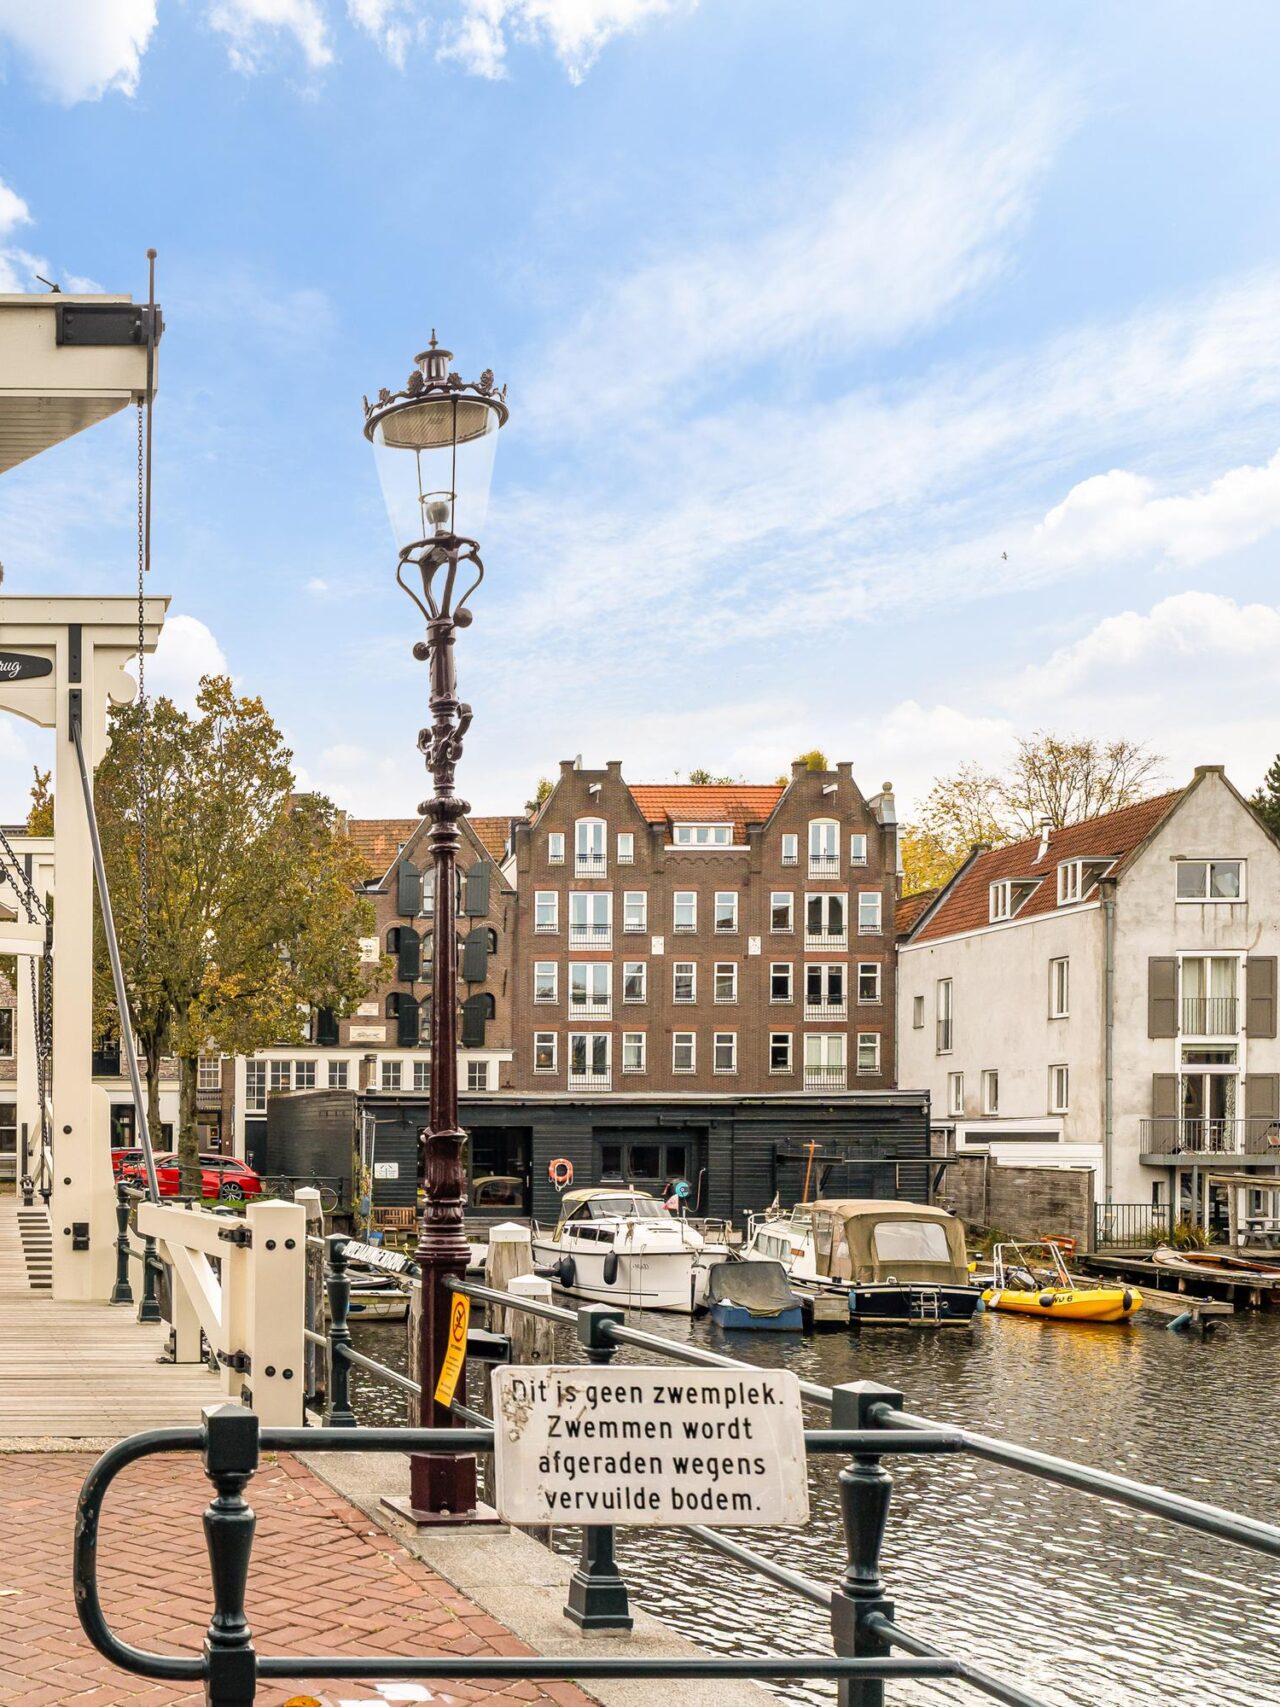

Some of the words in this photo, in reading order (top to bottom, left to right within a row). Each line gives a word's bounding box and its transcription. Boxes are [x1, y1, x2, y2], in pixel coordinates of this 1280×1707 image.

[512, 1379, 547, 1402] Dit
[557, 1380, 578, 1402] is
[585, 1385, 643, 1409] geen
[653, 1382, 784, 1409] zwemplek.
[547, 1415, 673, 1439] Zwemmen
[682, 1417, 753, 1440] wordt
[538, 1451, 663, 1480] afgeraden
[672, 1456, 766, 1482] wegens
[545, 1487, 661, 1510] vervuilde
[671, 1487, 762, 1511] bodem.
